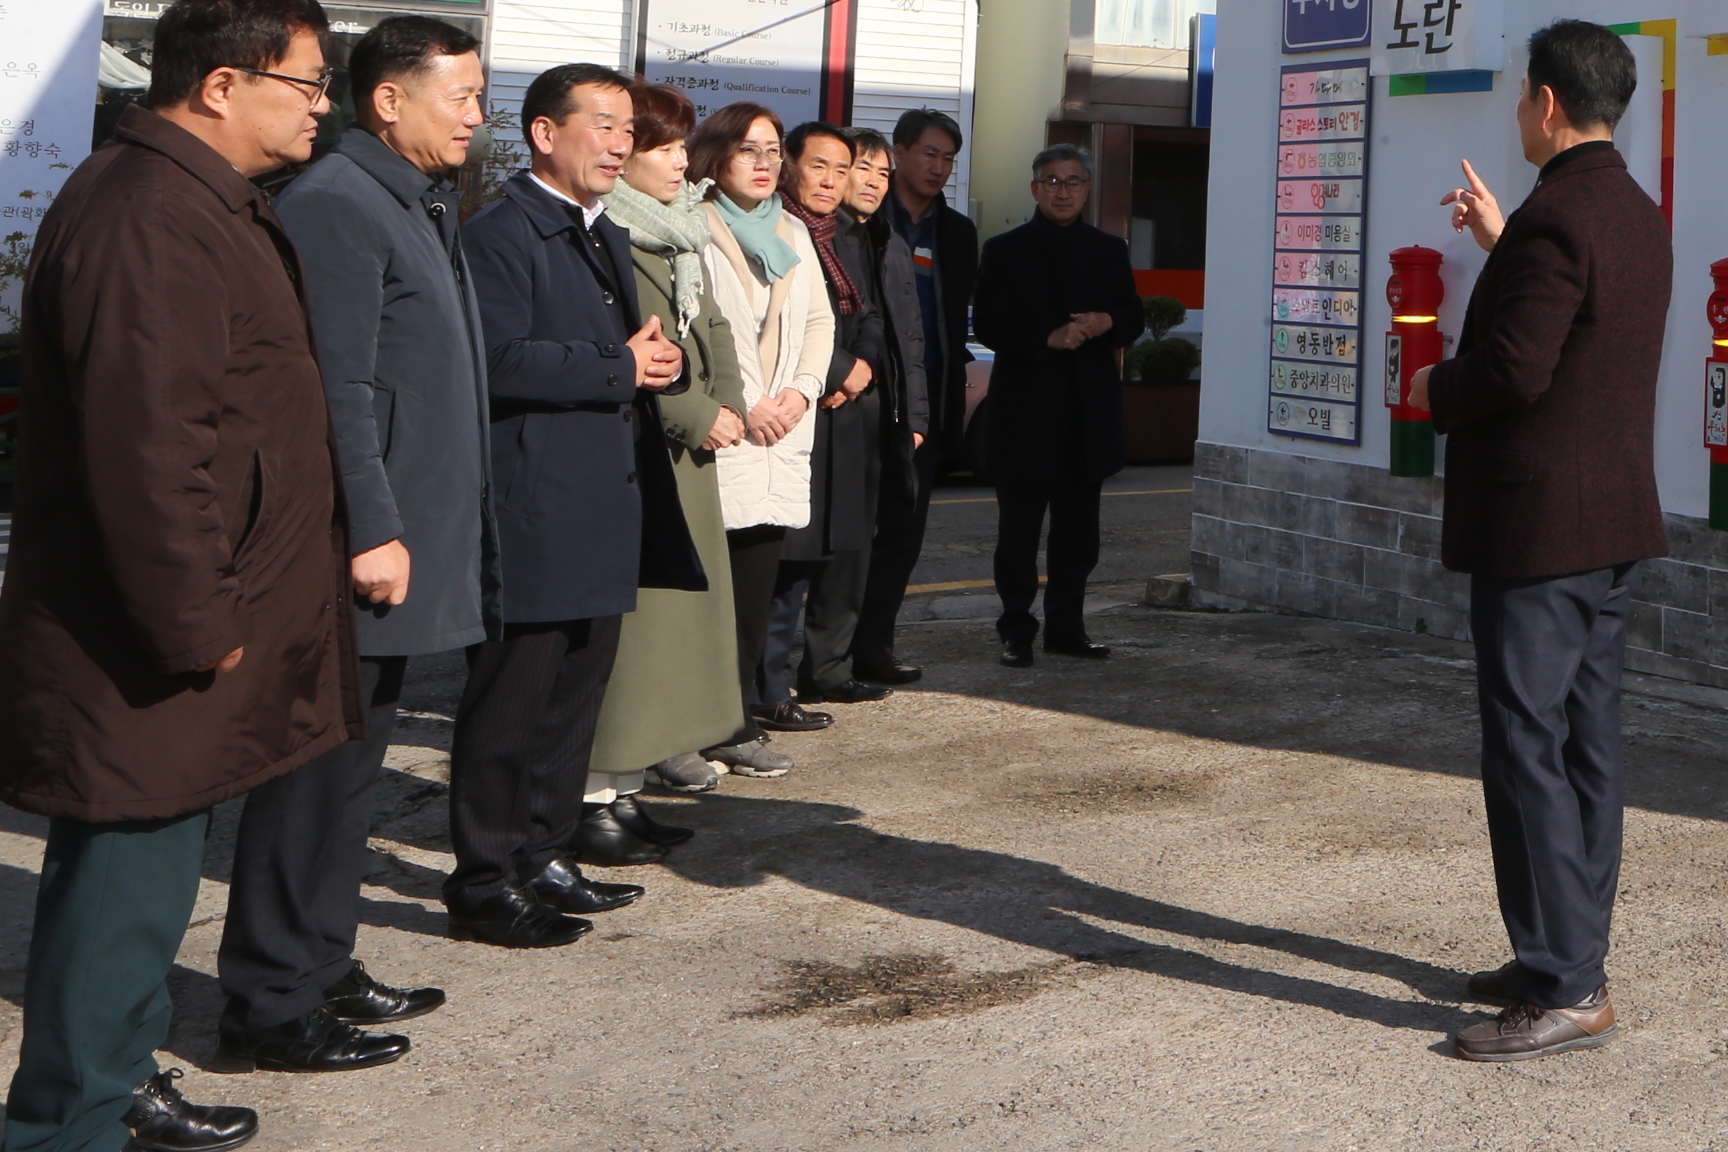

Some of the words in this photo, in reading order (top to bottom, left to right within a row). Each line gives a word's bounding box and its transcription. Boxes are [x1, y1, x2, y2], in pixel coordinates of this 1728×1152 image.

[667, 21, 712, 37] 기초과정
[714, 27, 741, 38] (Basic
[712, 54, 747, 66] (Regular
[749, 56, 780, 67] Course)
[664, 75, 720, 91] 자격증과정
[723, 82, 780, 95] (Qualification
[781, 85, 812, 96] Course)
[1338, 110, 1361, 132] 안경
[1307, 150, 1357, 169] 농협중앙회
[1297, 224, 1322, 243] 이미경
[1325, 224, 1351, 244] 미용실
[1296, 331, 1347, 357] 영동반점
[1289, 368, 1352, 395] 중앙치과의원
[1306, 406, 1332, 431] 오빌
